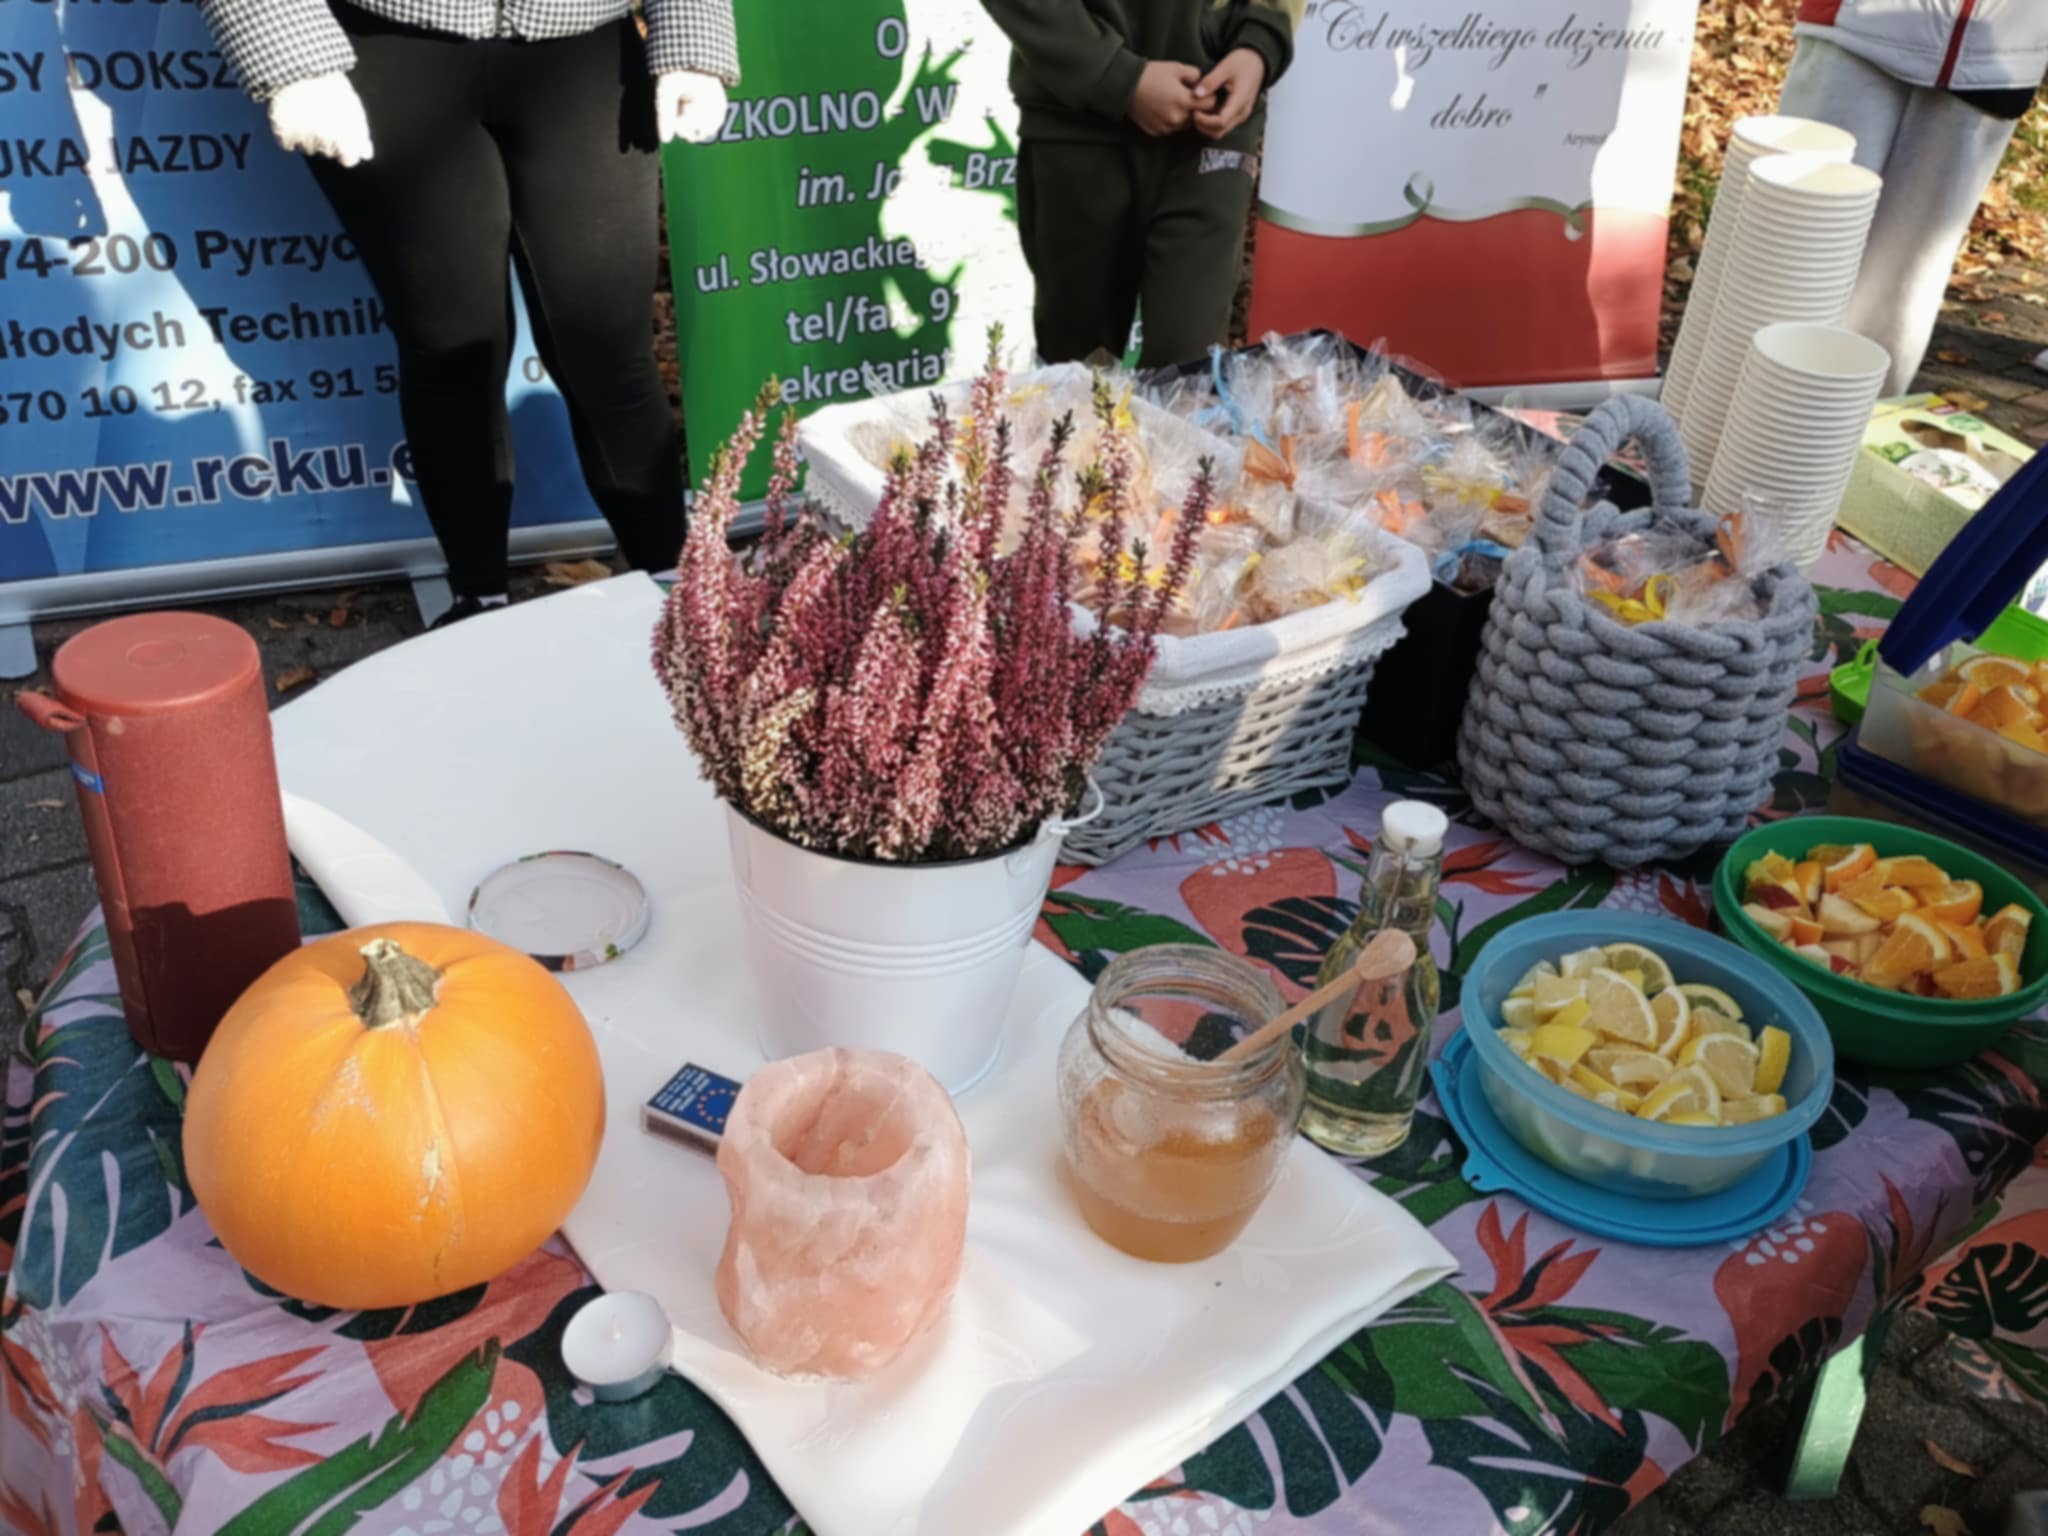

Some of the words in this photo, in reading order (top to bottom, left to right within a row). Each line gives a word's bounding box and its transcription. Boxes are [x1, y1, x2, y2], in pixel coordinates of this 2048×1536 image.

[699, 90, 880, 144] ZKOLNO
[1430, 92, 1513, 128] dobro
[797, 167, 856, 207] im.
[697, 254, 741, 292] ul.
[0, 311, 187, 361] łodych
[81, 384, 138, 417] 10
[234, 374, 298, 405] fax
[309, 367, 364, 400] 91
